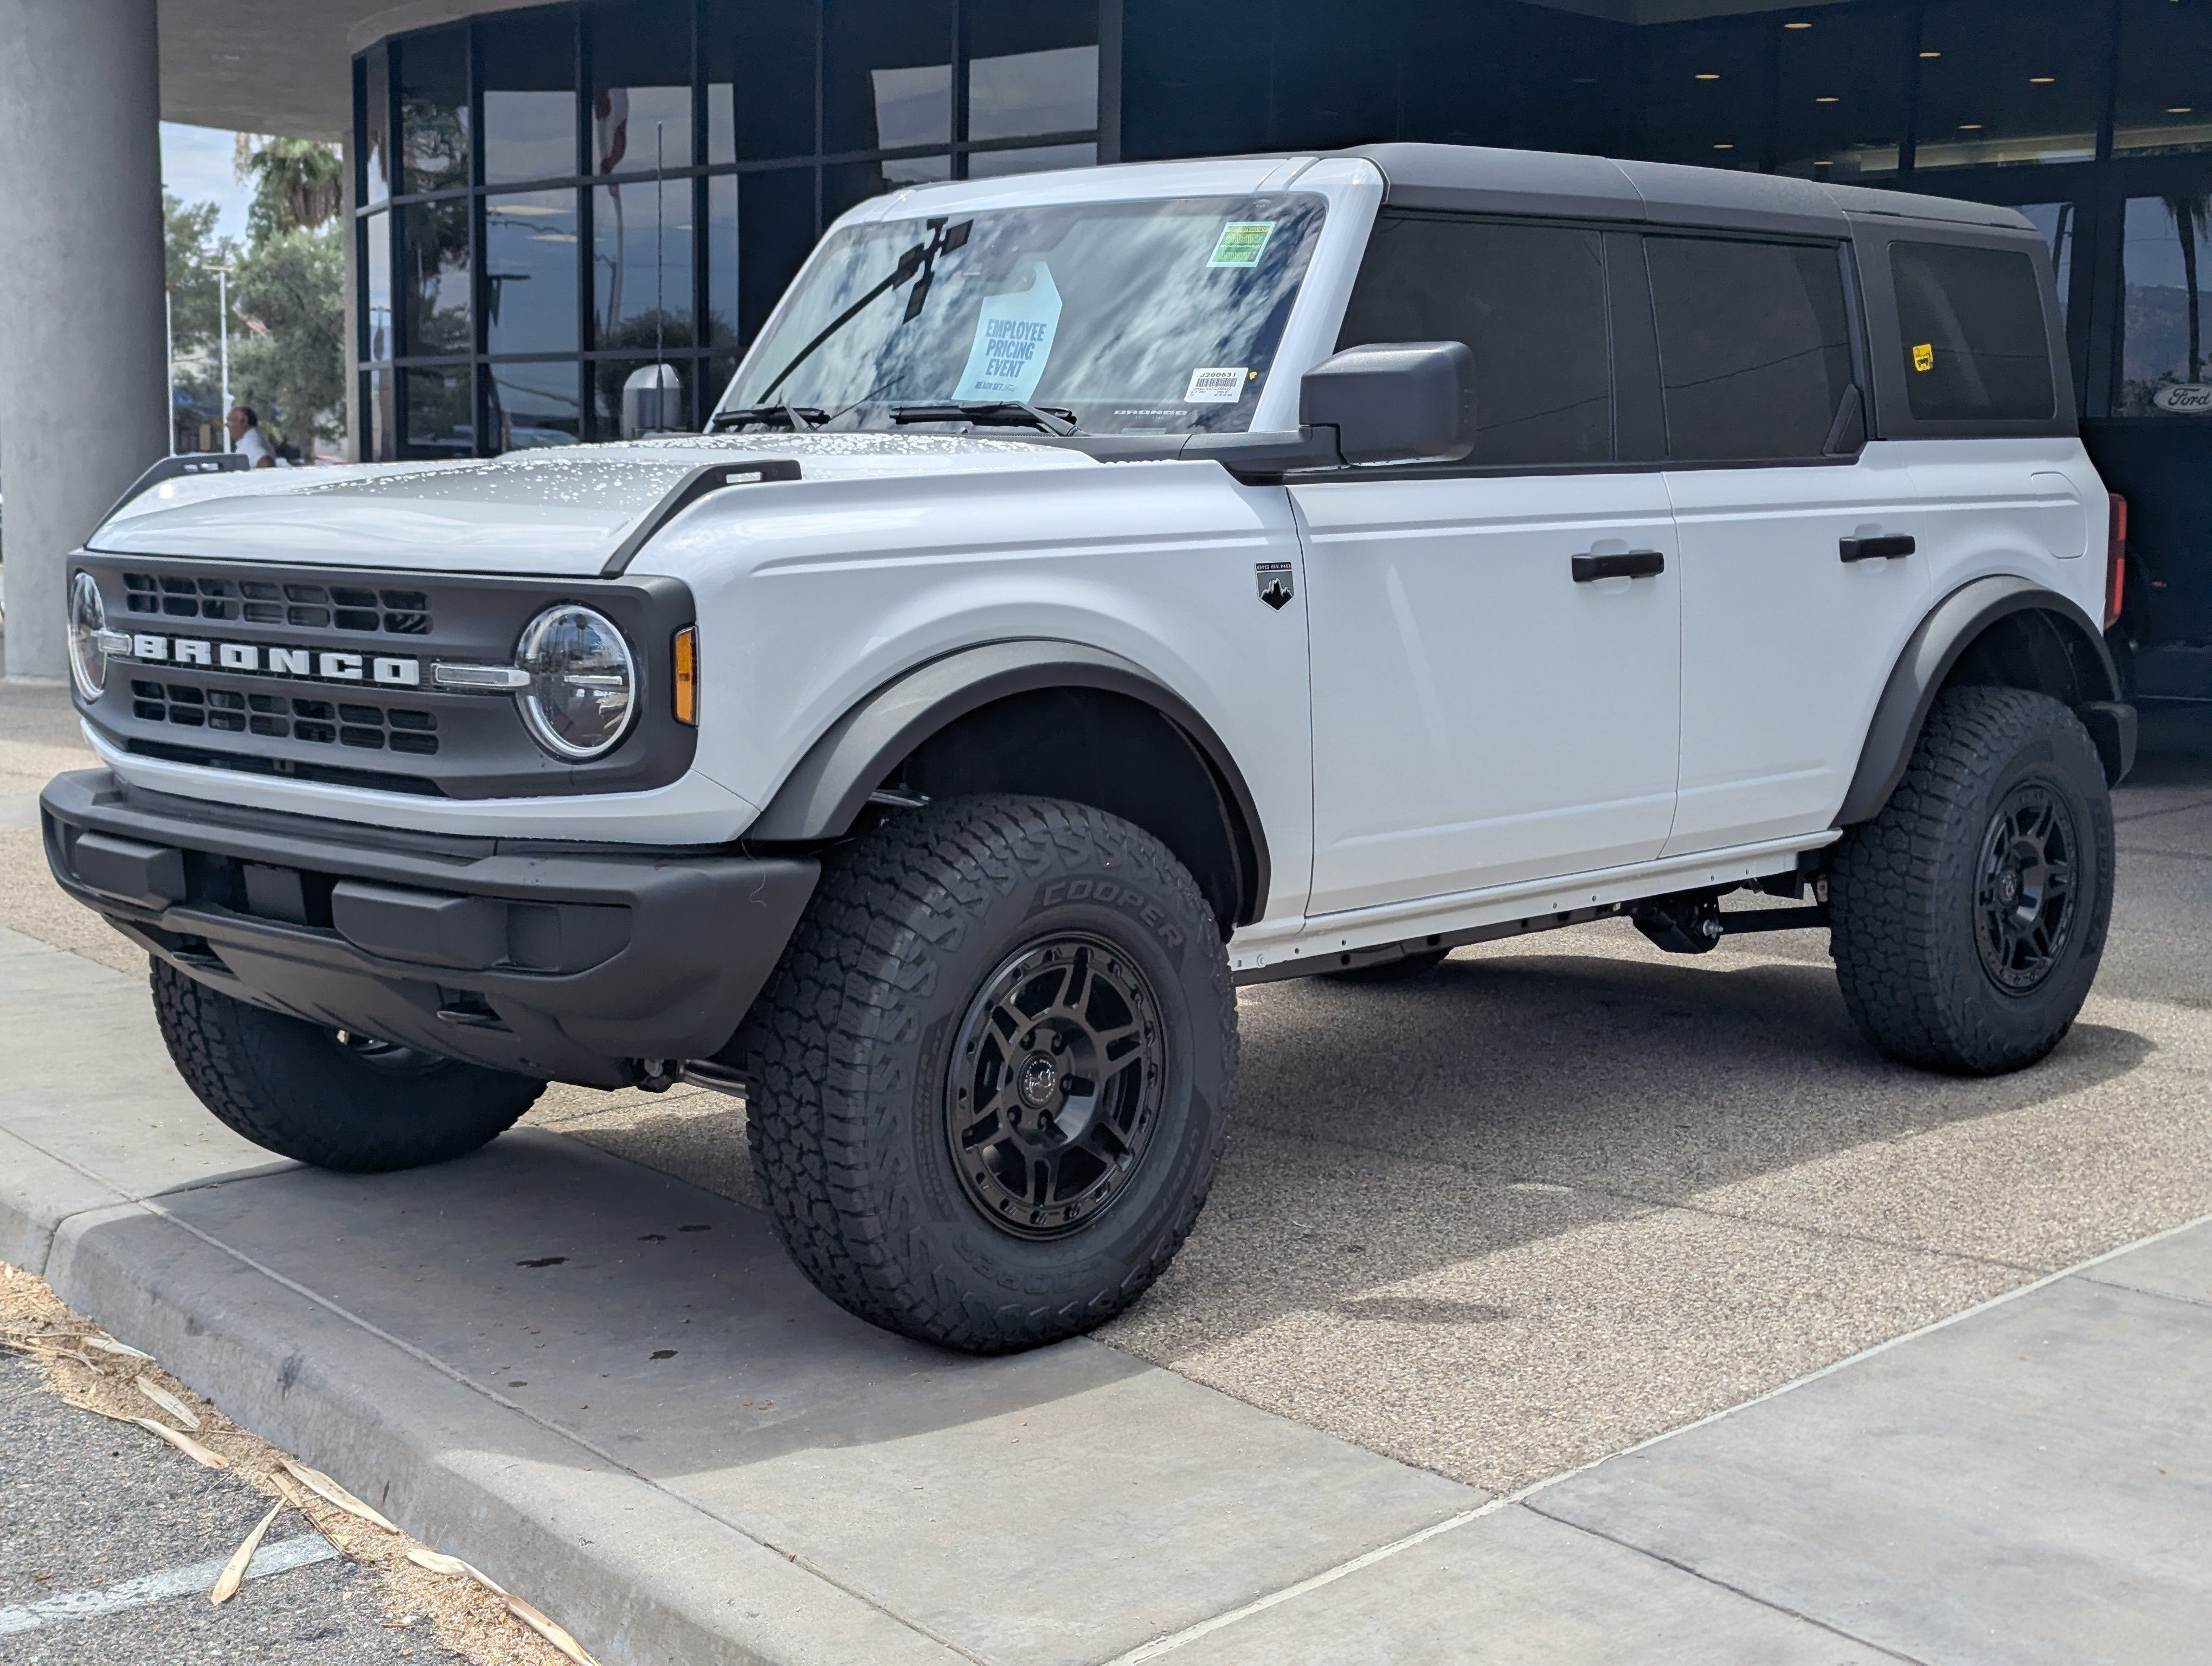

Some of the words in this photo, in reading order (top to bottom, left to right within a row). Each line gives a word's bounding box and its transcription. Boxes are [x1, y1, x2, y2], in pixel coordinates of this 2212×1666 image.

[985, 319, 1047, 342] EMPLOYEE
[985, 338, 1035, 360] PRICING
[985, 358, 1025, 377] EVENT
[2168, 388, 2210, 406] Ford
[134, 633, 420, 685] BRONCO
[1043, 879, 1182, 948] COOPER
